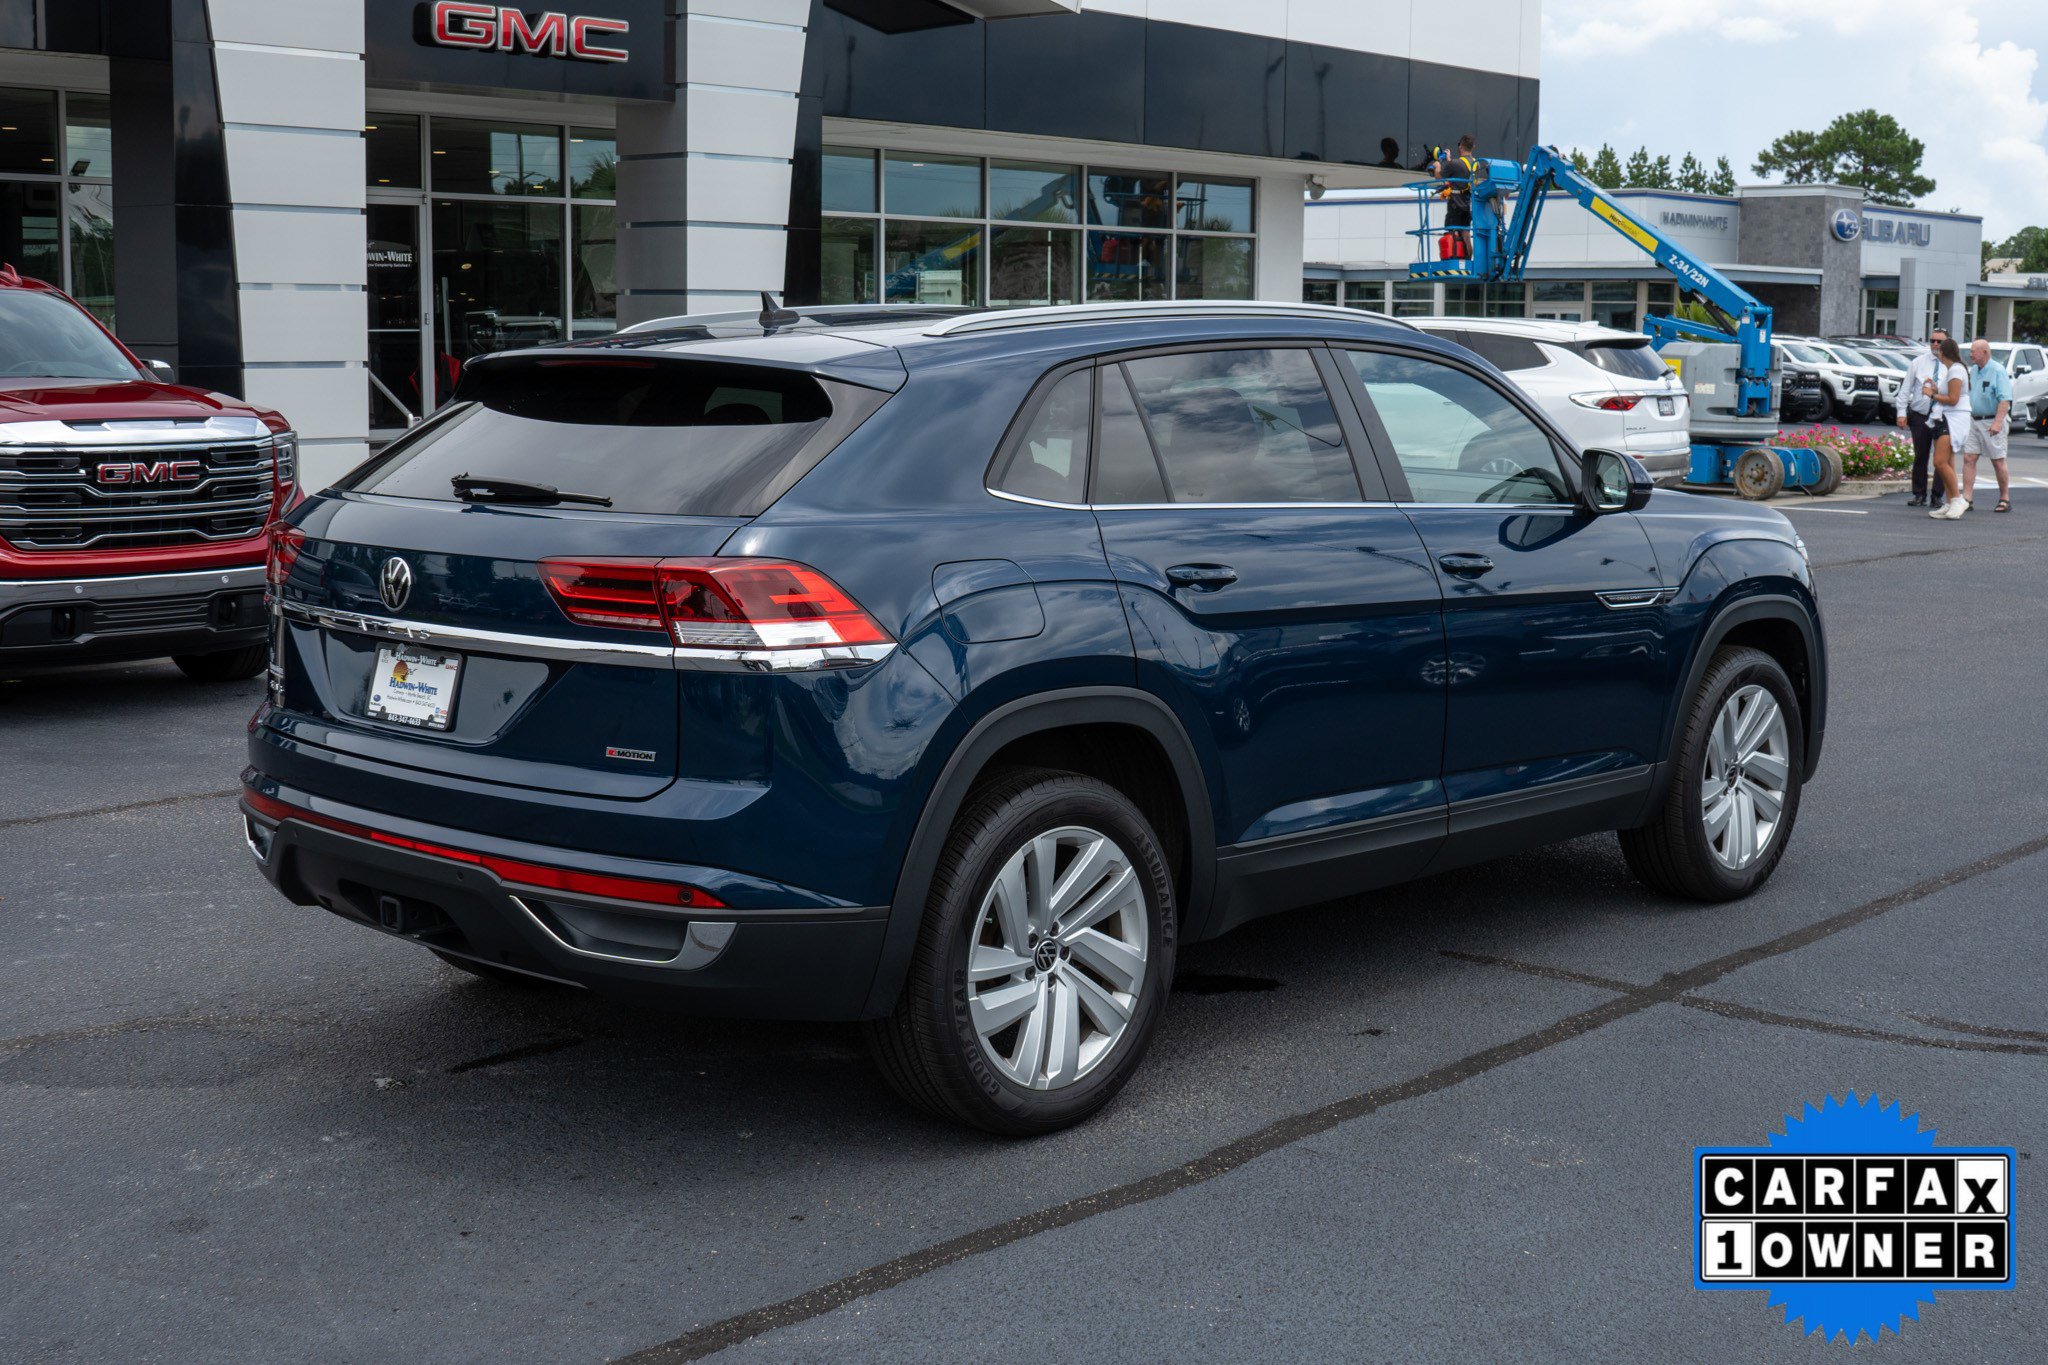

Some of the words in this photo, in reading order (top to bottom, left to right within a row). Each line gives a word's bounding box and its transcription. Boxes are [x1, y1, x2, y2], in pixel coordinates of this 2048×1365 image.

[433, 1, 629, 62] GMC
[1861, 217, 1930, 246] SUBARU
[1668, 254, 1710, 287] Z-34/22N
[97, 461, 200, 483] GMC
[358, 618, 431, 639] ATLAS
[388, 713, 421, 726] 843-347-4633
[1135, 832, 1173, 949] ASSURANCE
